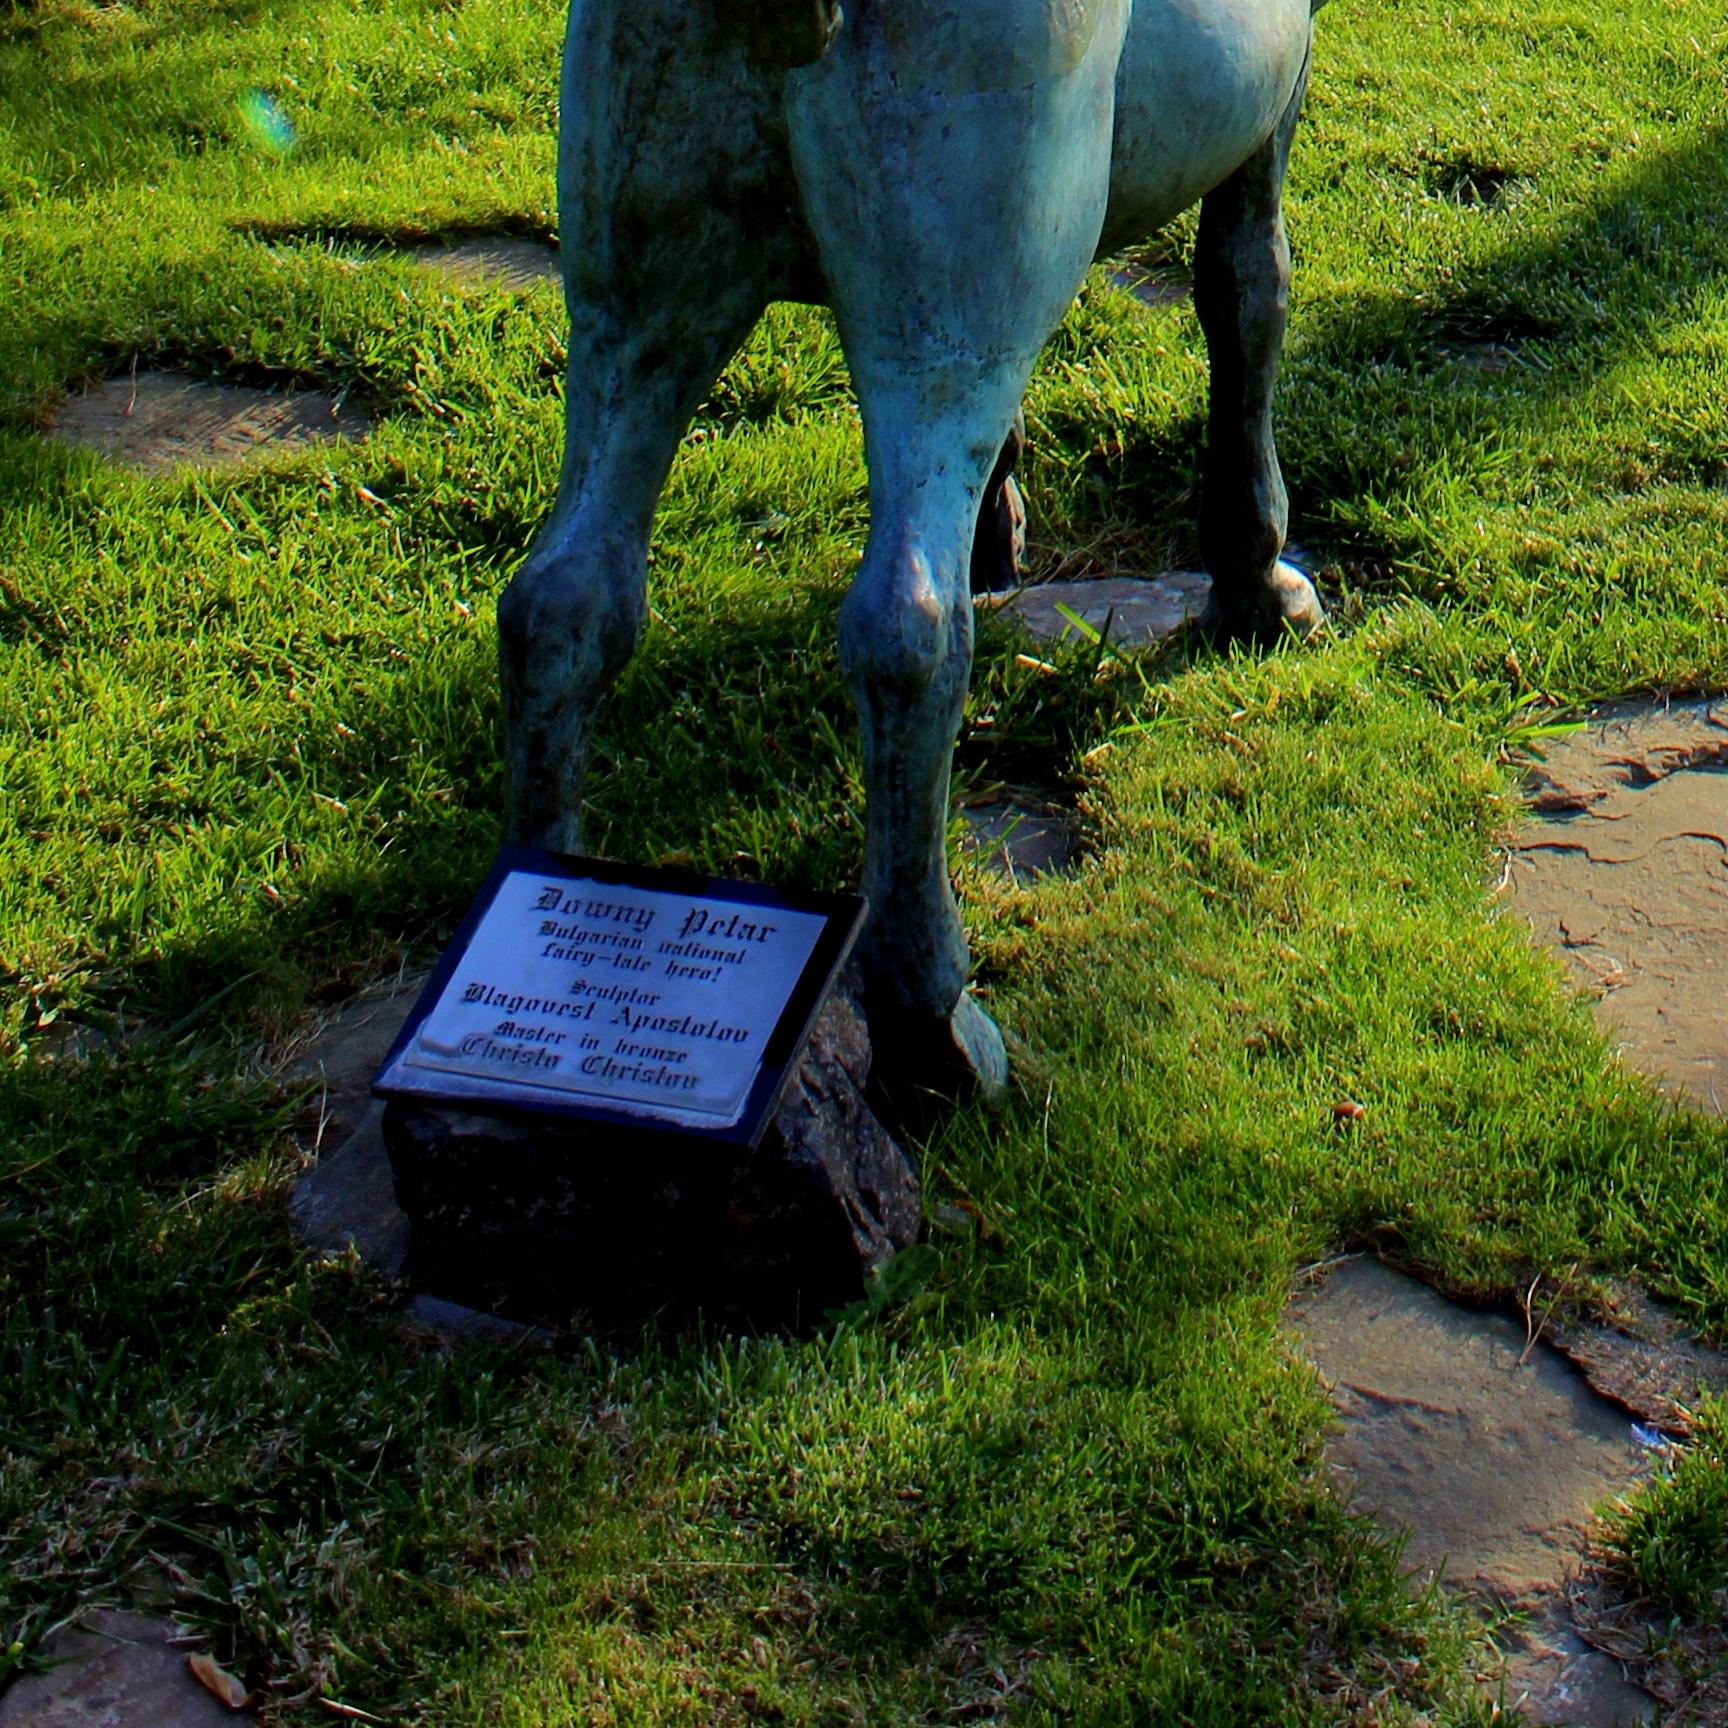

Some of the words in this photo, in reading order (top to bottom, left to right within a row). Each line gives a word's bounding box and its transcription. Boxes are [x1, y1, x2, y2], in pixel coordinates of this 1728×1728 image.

[537, 921, 643, 950] Bulgarian
[658, 939, 746, 965] national
[678, 907, 778, 942] Petar
[569, 979, 661, 1006] Sculptor
[665, 960, 723, 982] hero!
[461, 982, 596, 1020] Blagovest
[610, 1006, 750, 1043] Apostolov
[461, 1037, 560, 1068] Christo
[580, 1055, 703, 1089] Christov
[494, 1021, 566, 1045] Master
[580, 1033, 600, 1050] in
[614, 1038, 689, 1064] bronze
